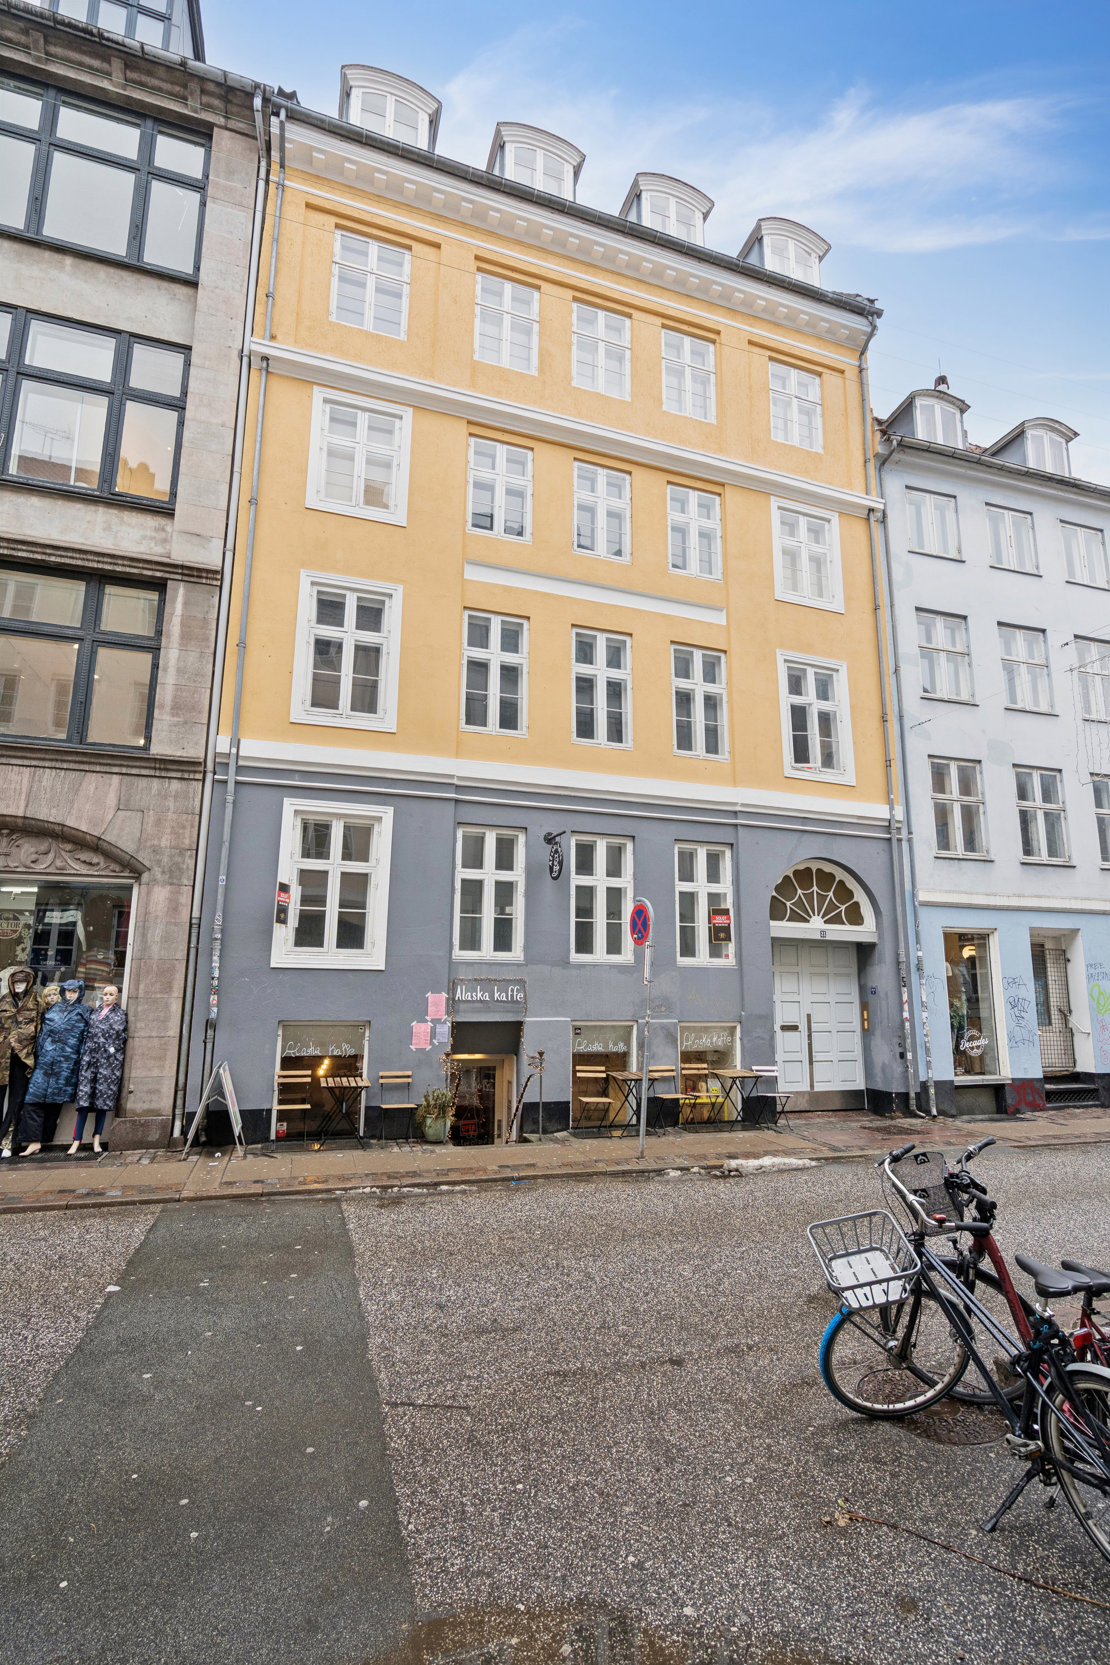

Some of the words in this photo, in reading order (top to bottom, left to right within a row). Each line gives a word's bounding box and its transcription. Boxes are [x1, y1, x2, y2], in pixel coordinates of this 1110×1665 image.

[455, 985, 490, 1001] Alaska
[494, 985, 524, 1002] kaffe
[282, 1041, 322, 1058] Alaska
[574, 1038, 605, 1053] Alaska
[682, 1032, 712, 1050] Alaska
[960, 1036, 989, 1050] Decades
